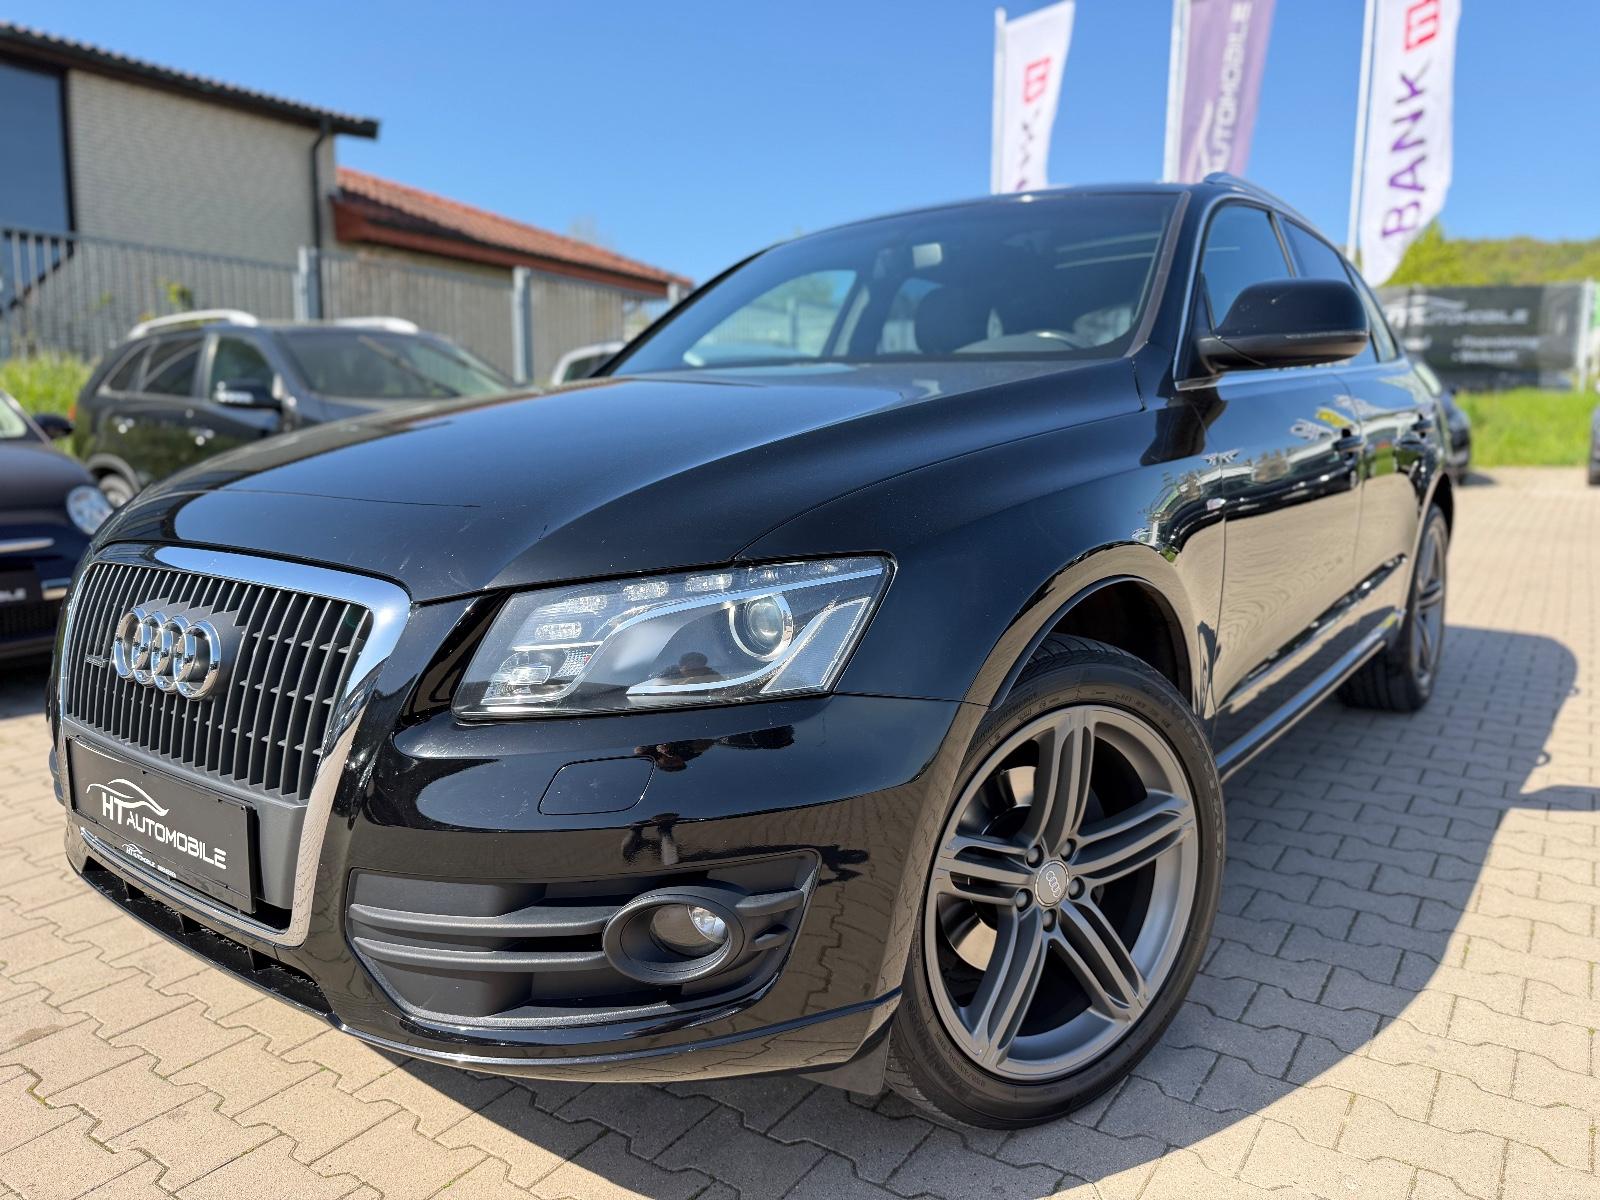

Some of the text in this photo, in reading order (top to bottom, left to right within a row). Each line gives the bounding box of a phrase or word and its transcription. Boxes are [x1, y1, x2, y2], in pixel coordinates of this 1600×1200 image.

[1381, 58, 1433, 238] BANK
[102, 791, 227, 870] HT AUTOMOBILE
